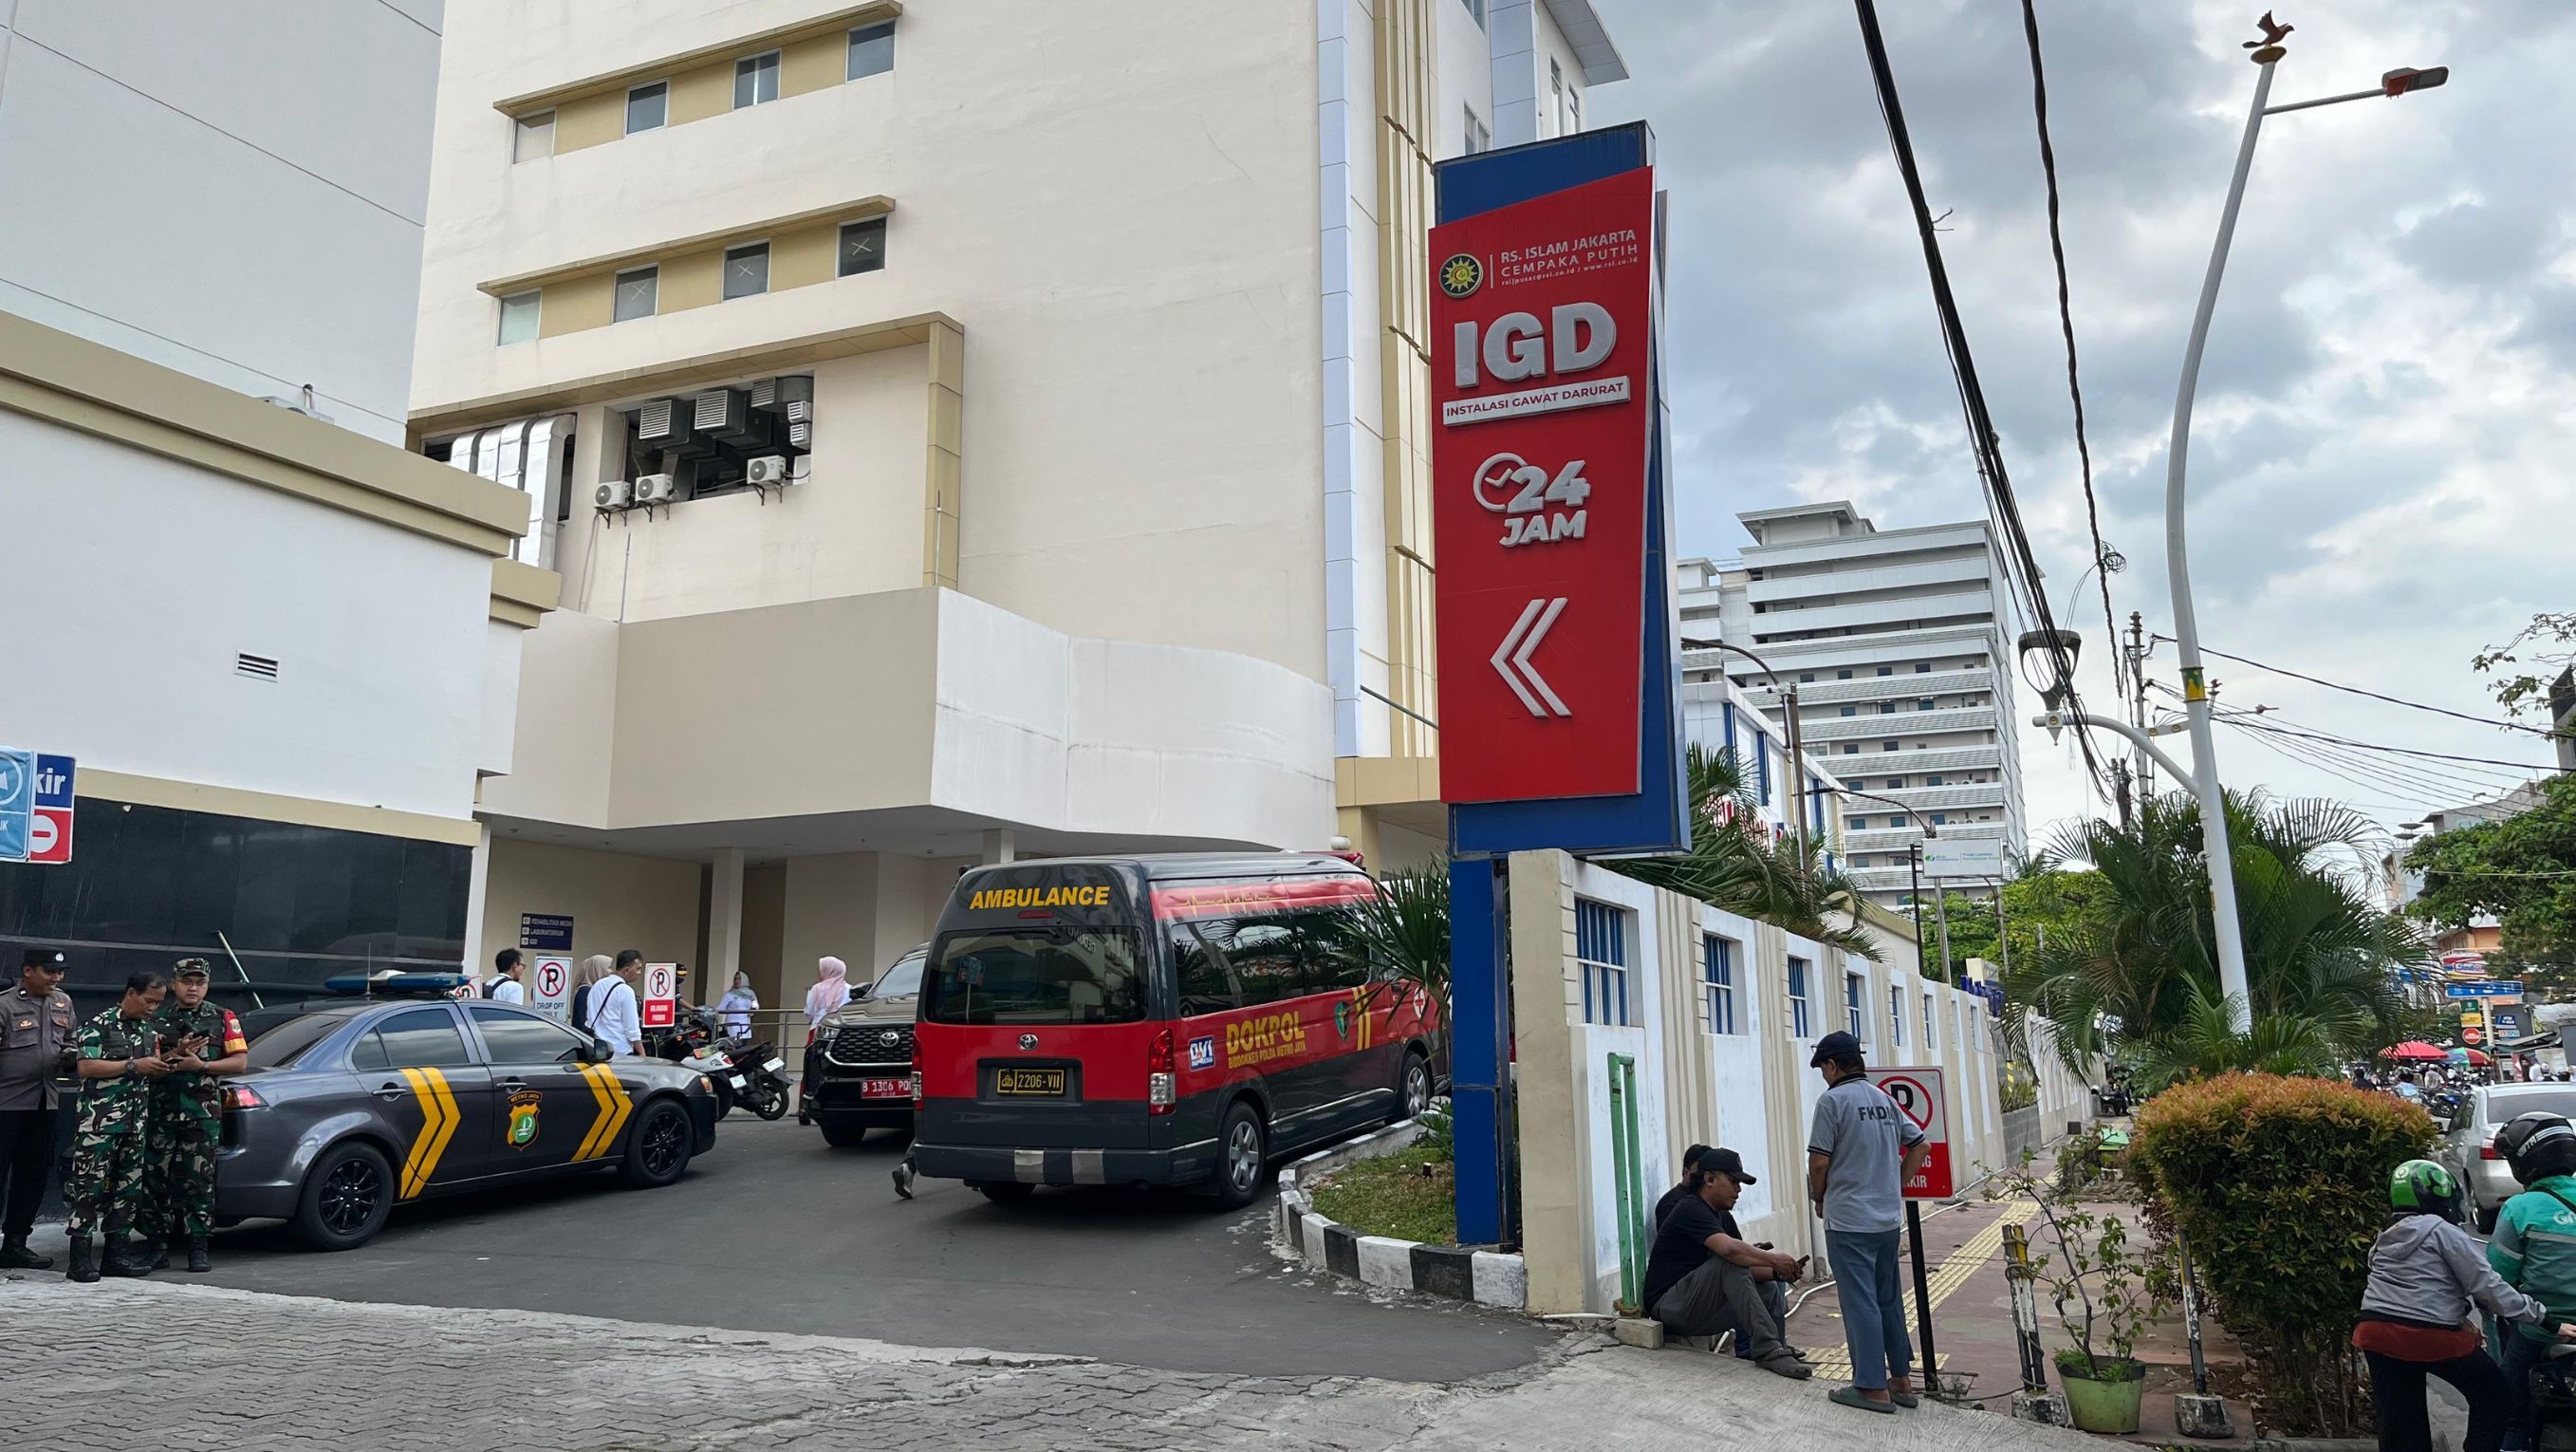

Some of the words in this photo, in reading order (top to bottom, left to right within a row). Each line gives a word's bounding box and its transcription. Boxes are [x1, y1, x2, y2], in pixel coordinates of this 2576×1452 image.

[1501, 251, 1522, 264] RS.
[1525, 241, 1568, 260] ISLAM
[1571, 229, 1636, 251] JAKARTA
[1501, 255, 1579, 277] CEMPAKA
[1586, 244, 1638, 263] PUTIH
[1455, 302, 1617, 389] IGD
[1446, 400, 1510, 418] INSTALASI
[1512, 392, 1559, 407] GAWAT
[1562, 382, 1624, 400] DARURAT
[1507, 459, 1591, 514] 24
[1499, 510, 1587, 548] JAM
[969, 886, 1110, 910] AMBULANCE
[1226, 1011, 1306, 1055] DOKPOL
[862, 1082, 868, 1092] B
[1906, 1175, 1928, 1188] KIR
